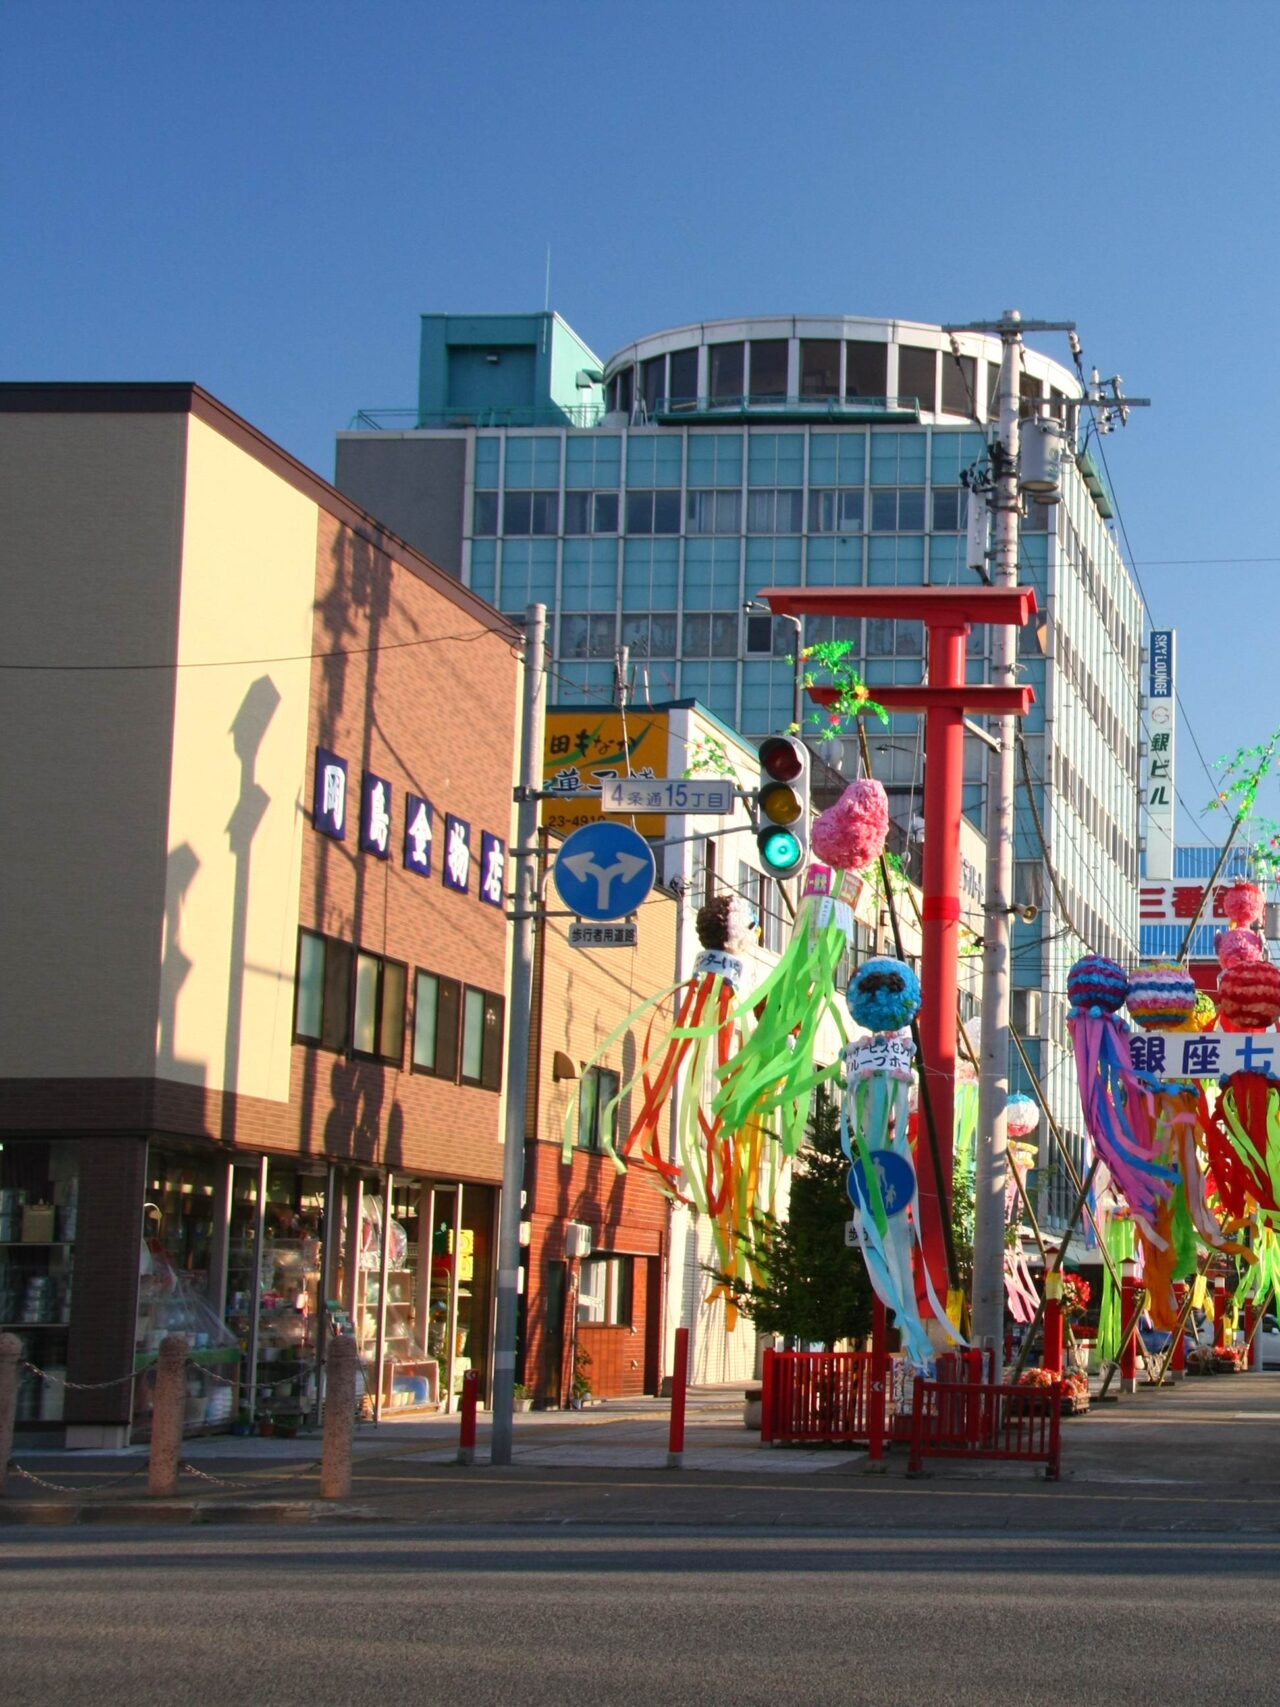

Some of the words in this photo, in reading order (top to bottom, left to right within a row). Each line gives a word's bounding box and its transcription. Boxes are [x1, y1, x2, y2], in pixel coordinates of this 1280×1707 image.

[1154, 634, 1168, 655] SKY
[1154, 656, 1168, 696] LOUNGE
[1150, 732, 1170, 805] 銀ビル
[611, 783, 724, 808] 4条通15丁目
[323, 764, 505, 903] 岡島金物店
[572, 928, 635, 943] 歩行者用道路
